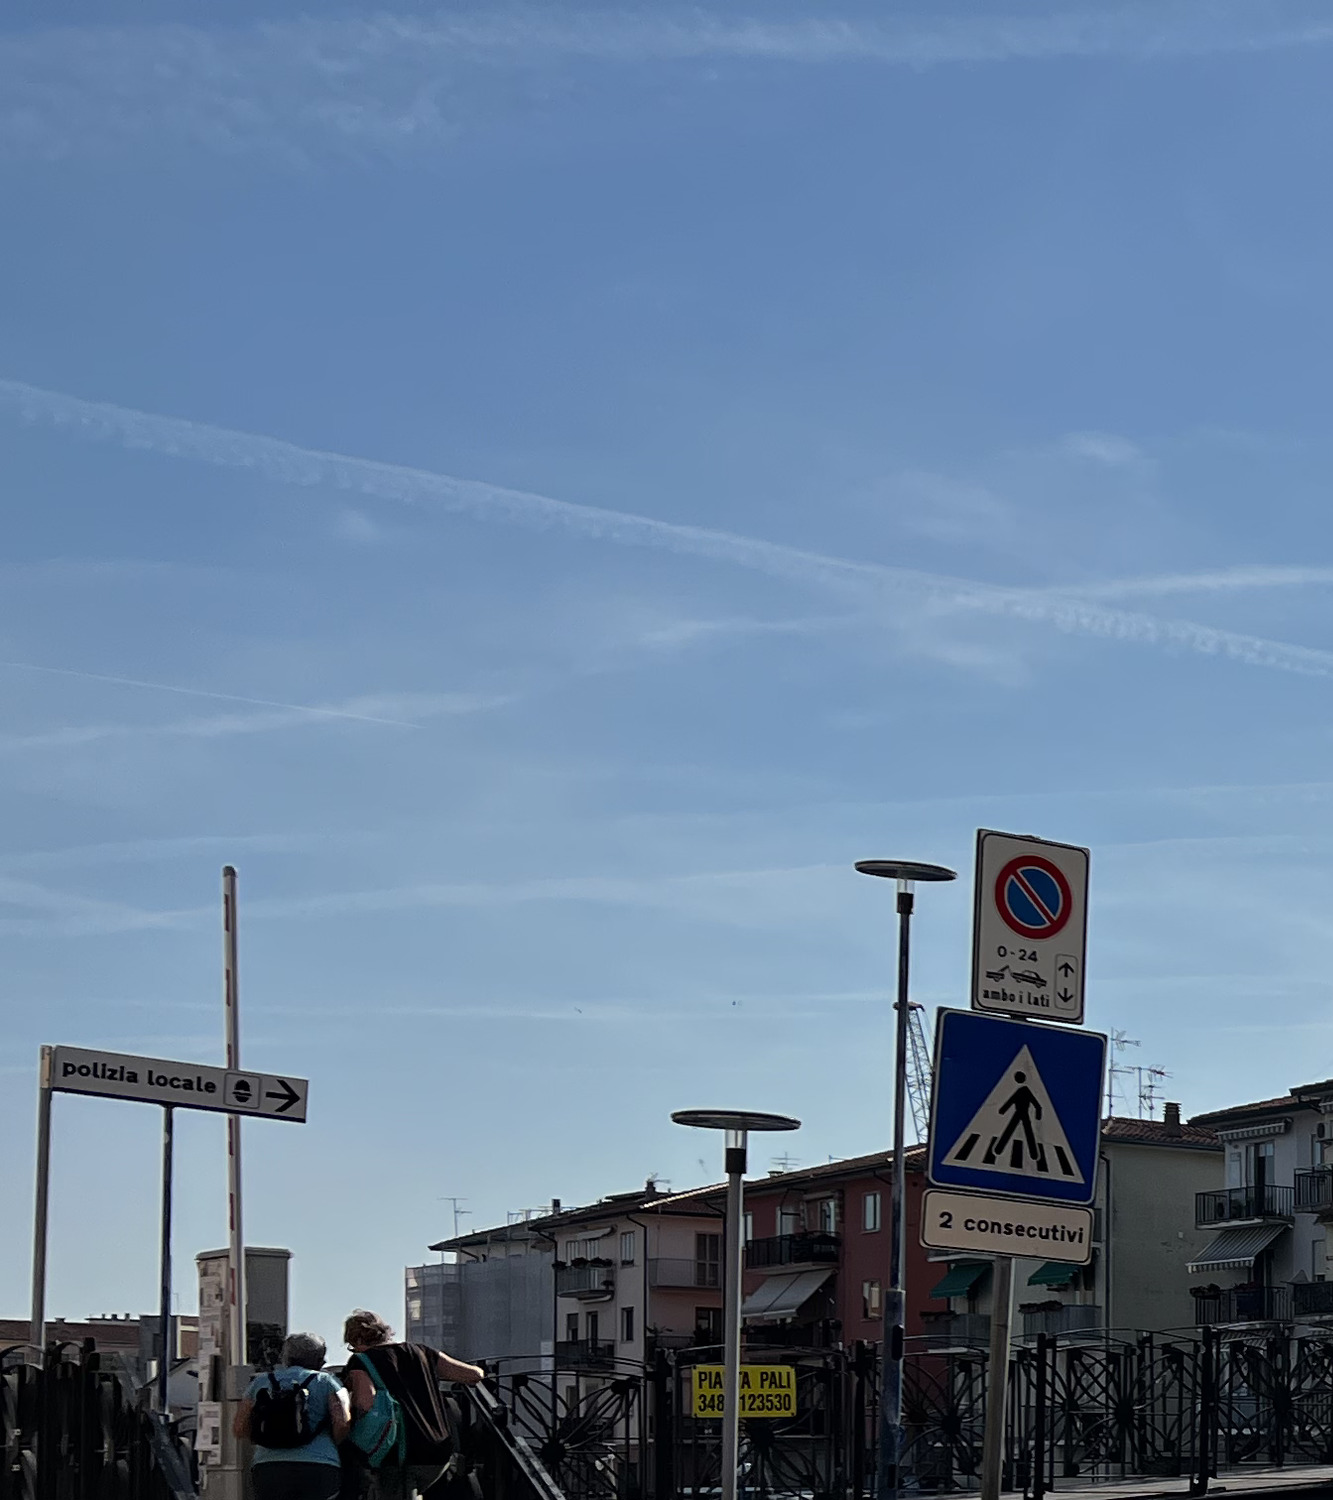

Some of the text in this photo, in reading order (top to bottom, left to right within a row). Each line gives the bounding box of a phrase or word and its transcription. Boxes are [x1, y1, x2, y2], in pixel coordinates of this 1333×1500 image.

[983, 988, 1050, 1008] ambo i lati
[62, 1062, 217, 1093] polizia locale
[939, 1211, 1084, 1243] 2 consecutivi
[698, 1371, 791, 1389] PIAA PALI
